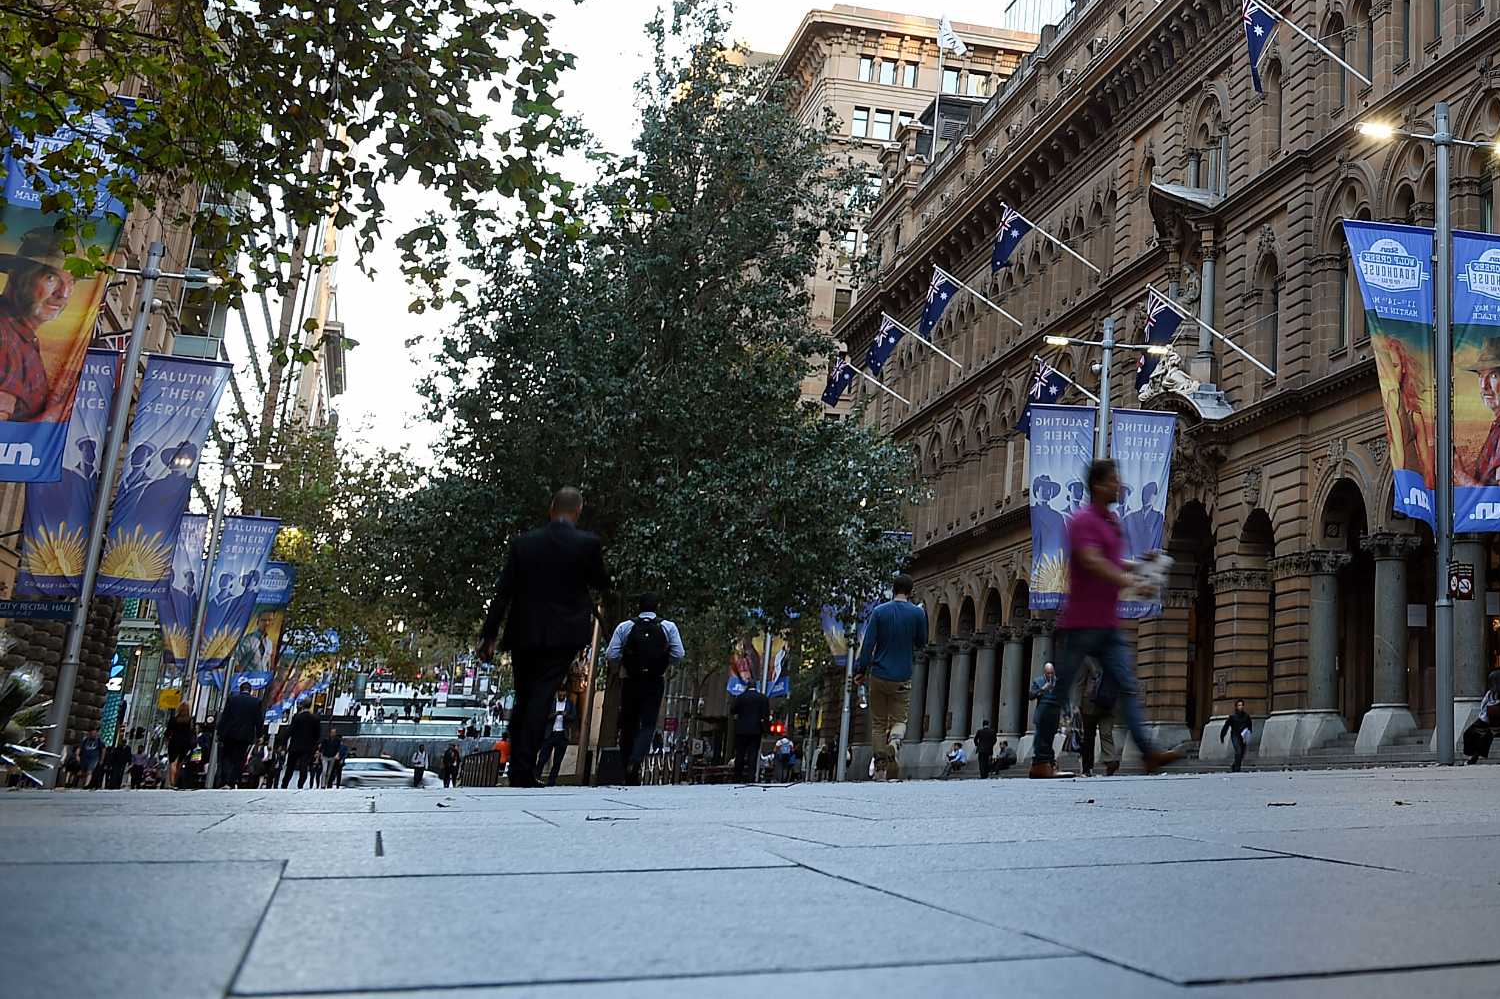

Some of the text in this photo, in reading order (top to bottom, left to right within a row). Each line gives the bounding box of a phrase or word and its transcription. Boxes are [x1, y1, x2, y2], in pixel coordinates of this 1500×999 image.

[160, 386, 206, 401] THEIR
[227, 523, 275, 534] SALUTING
[235, 534, 265, 543] THEIR
[20, 602, 49, 612] RECITAL
[52, 603, 71, 612] HALL
